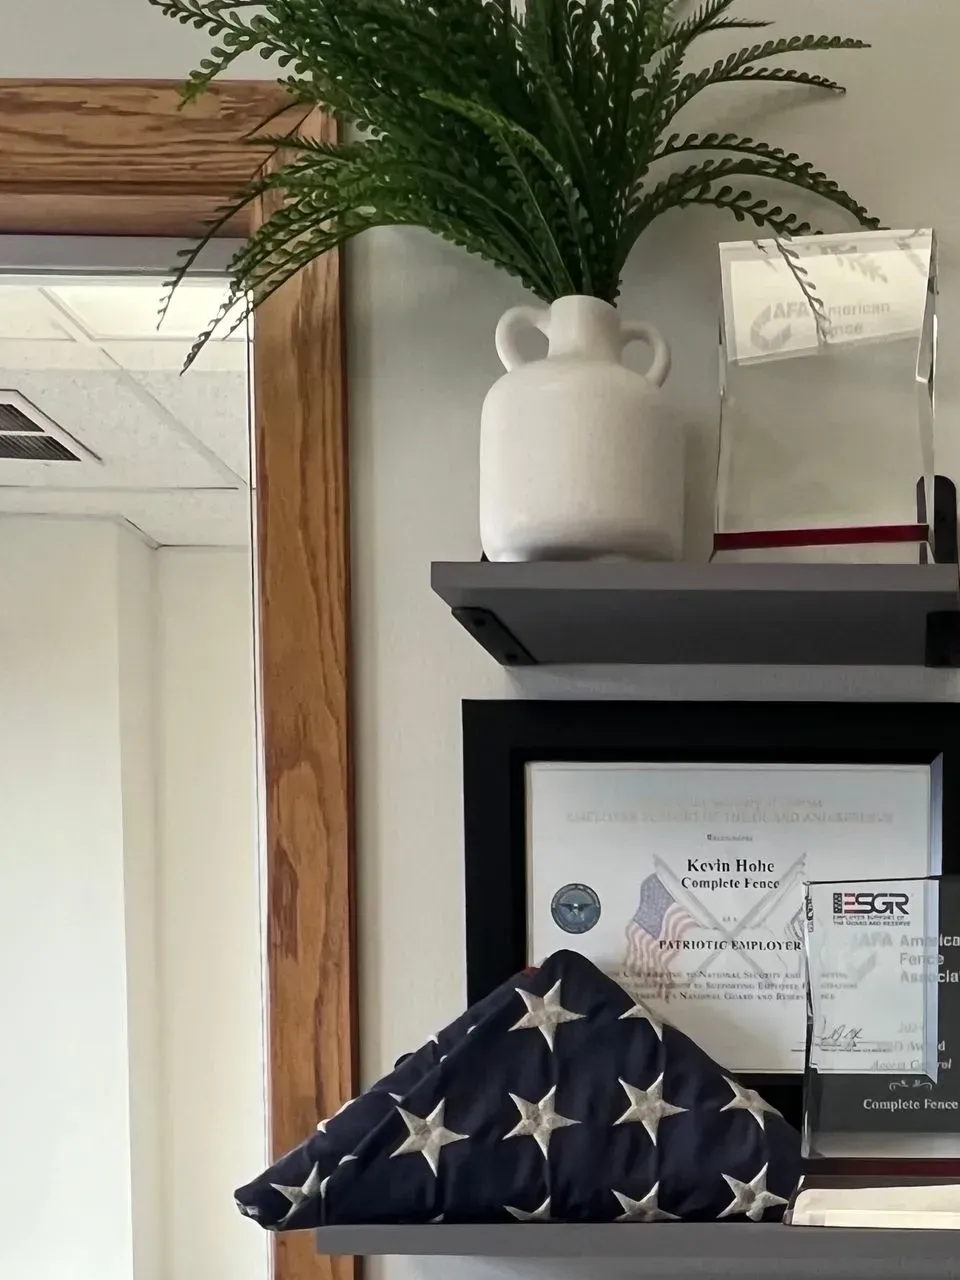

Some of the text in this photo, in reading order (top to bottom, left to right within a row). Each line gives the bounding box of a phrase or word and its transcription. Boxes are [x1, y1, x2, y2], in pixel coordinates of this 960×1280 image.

[820, 301, 890, 317] merican
[687, 858, 775, 873] Kevin Hohe
[681, 876, 780, 891] Complete Fence
[833, 893, 910, 914] ESGR
[659, 939, 802, 952] PATRIOTIC EMPLOYER
[863, 1098, 959, 1112] Complete Fence
